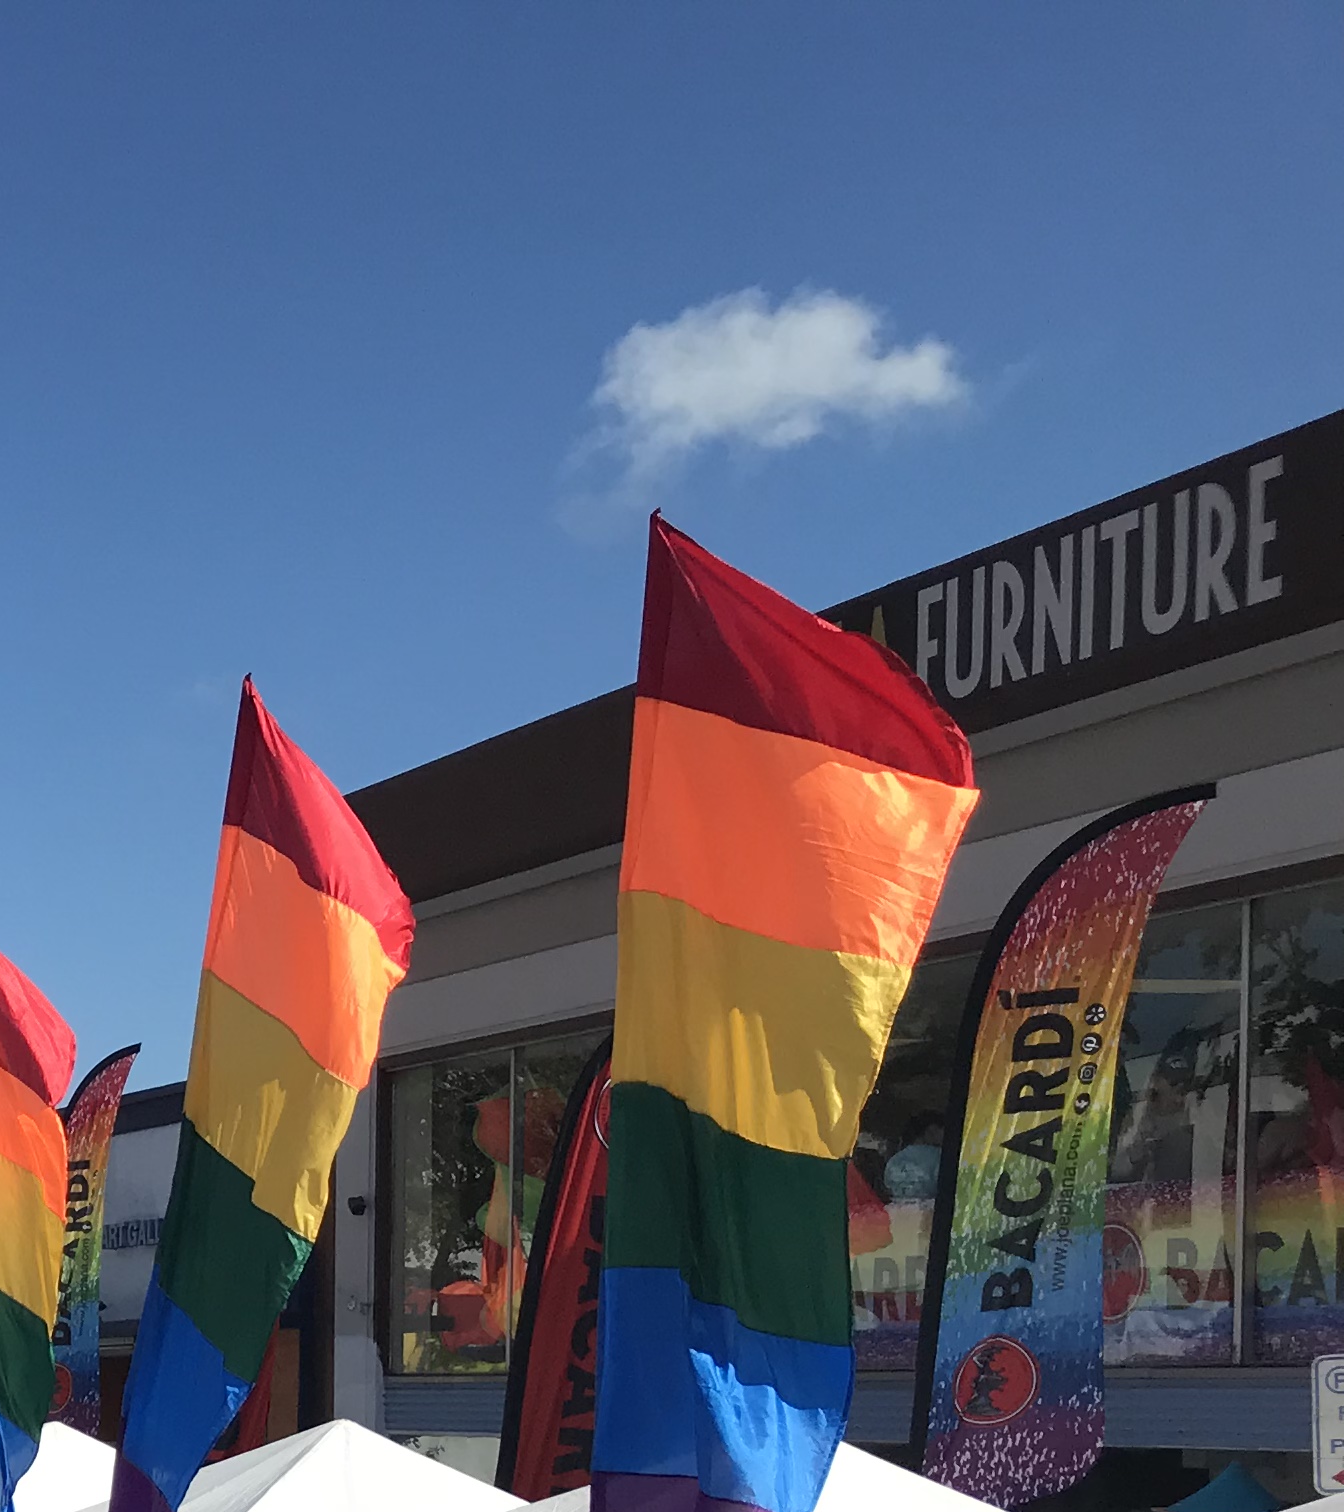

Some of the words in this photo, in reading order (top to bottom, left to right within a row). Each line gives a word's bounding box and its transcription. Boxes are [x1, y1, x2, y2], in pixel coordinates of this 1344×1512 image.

[916, 454, 1285, 699] FURNITURE
[980, 987, 1080, 1313] BACARDÍ
[1165, 1229, 1344, 1311] BACA
